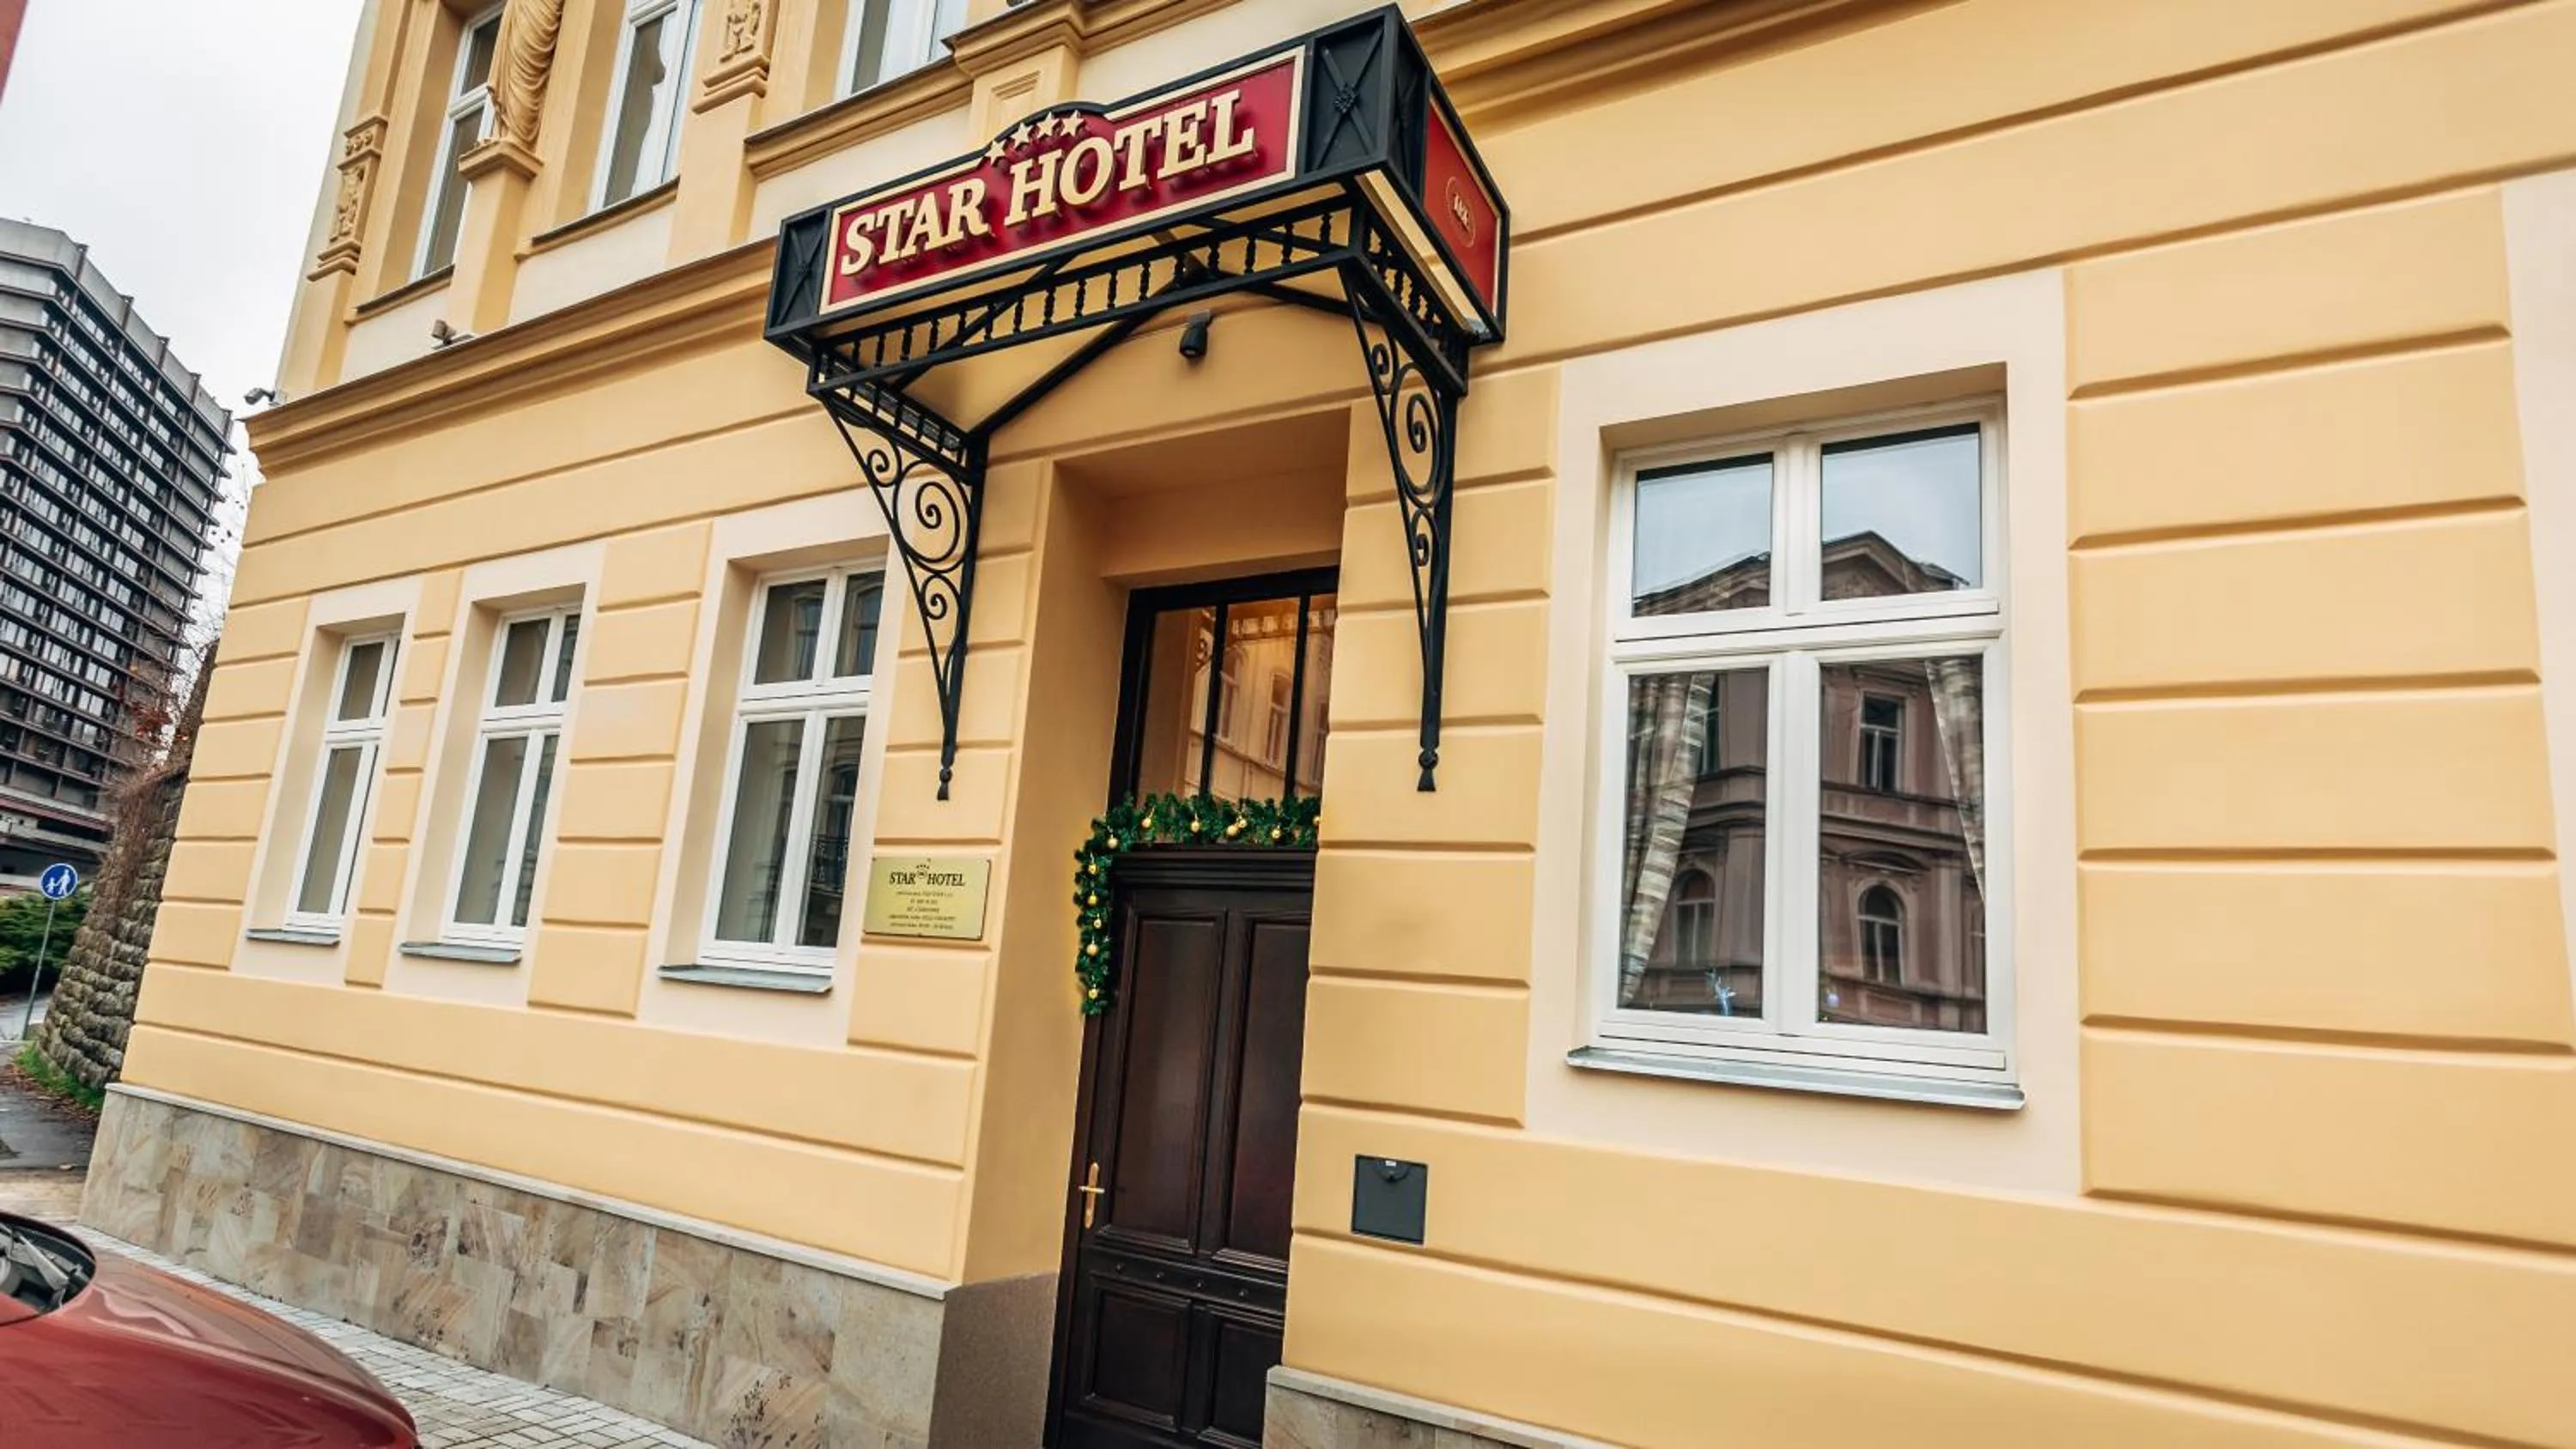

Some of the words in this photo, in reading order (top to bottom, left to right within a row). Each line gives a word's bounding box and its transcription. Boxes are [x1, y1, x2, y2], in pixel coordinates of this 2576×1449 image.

[841, 177, 989, 276] STAR
[1005, 89, 1256, 225] HOTEL
[889, 871, 916, 885] STAR
[927, 873, 966, 887] HOTEL
